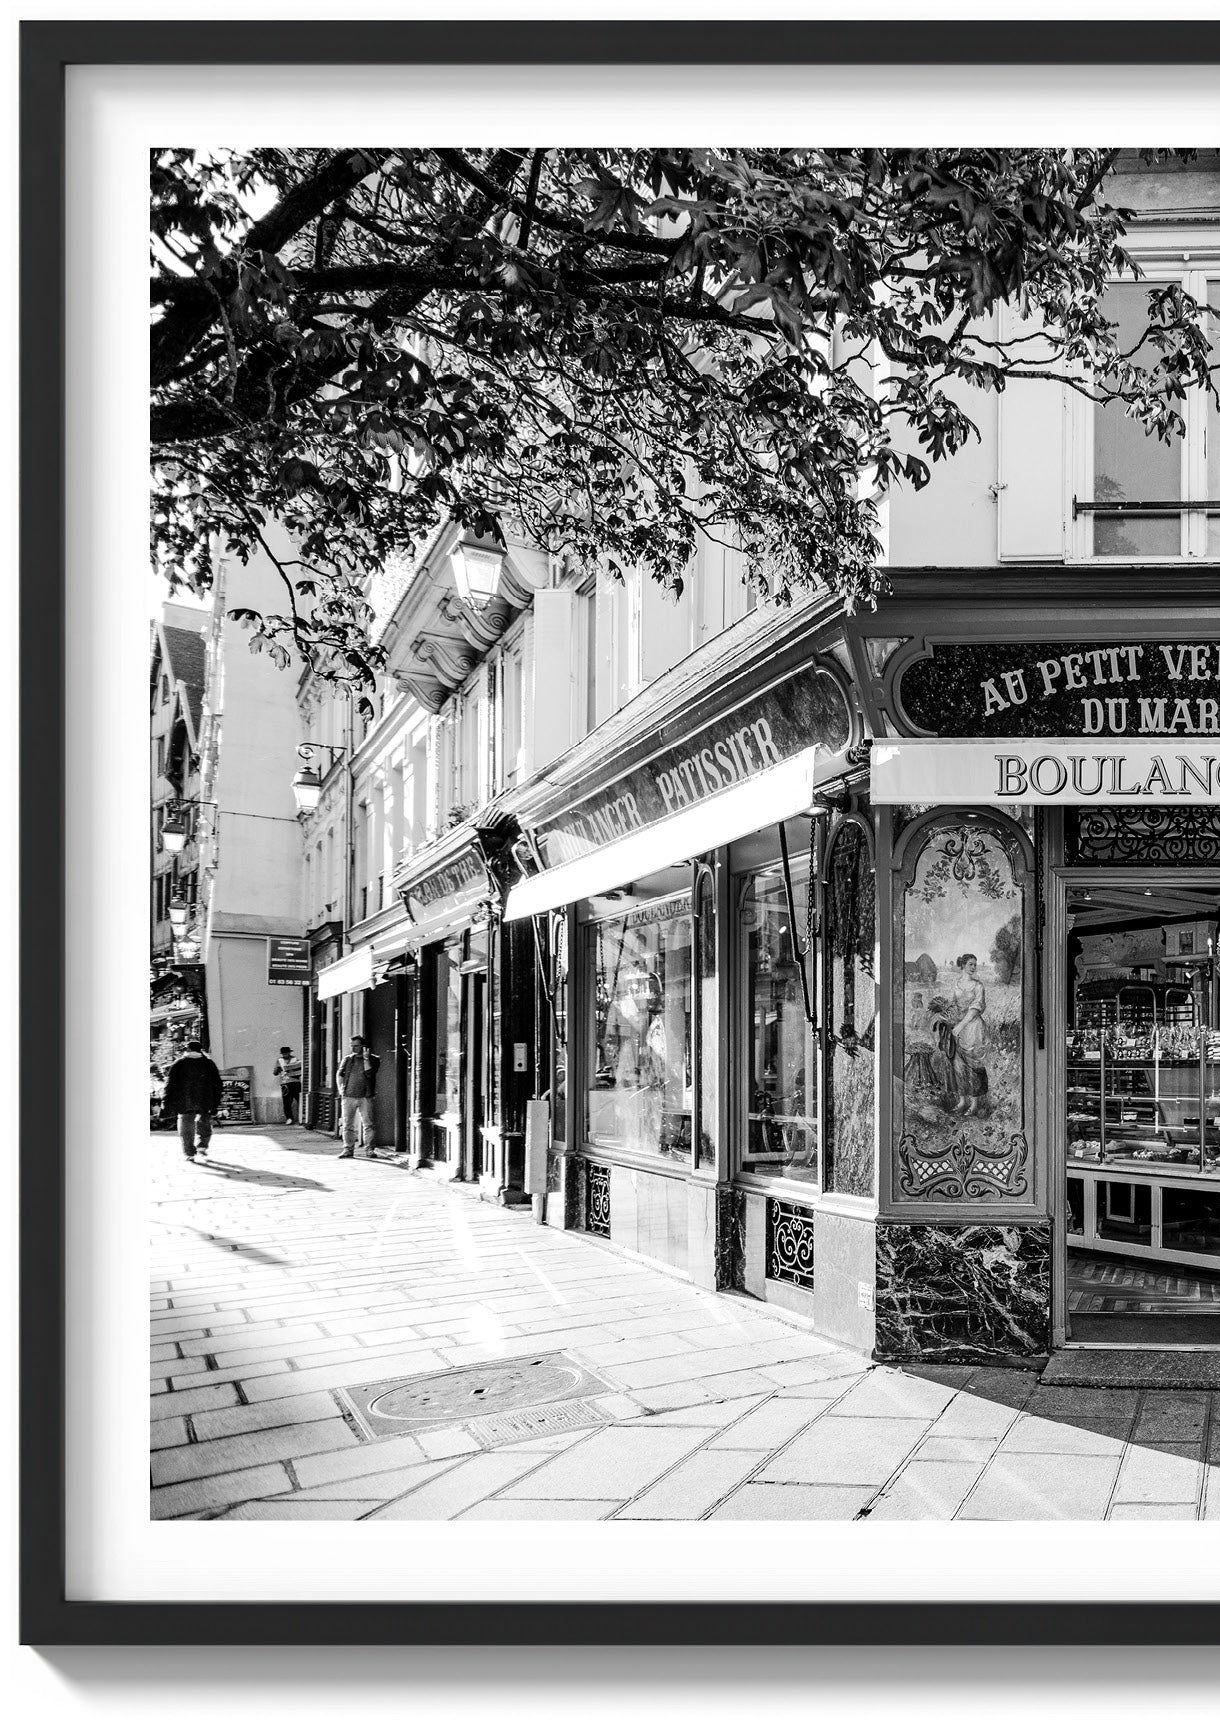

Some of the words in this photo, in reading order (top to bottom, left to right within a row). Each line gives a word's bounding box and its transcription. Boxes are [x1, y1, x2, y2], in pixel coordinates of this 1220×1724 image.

[980, 669, 1028, 717] AU
[1036, 644, 1146, 696] PETIT
[1081, 697, 1128, 735] DU
[655, 717, 784, 814] PATISSIER
